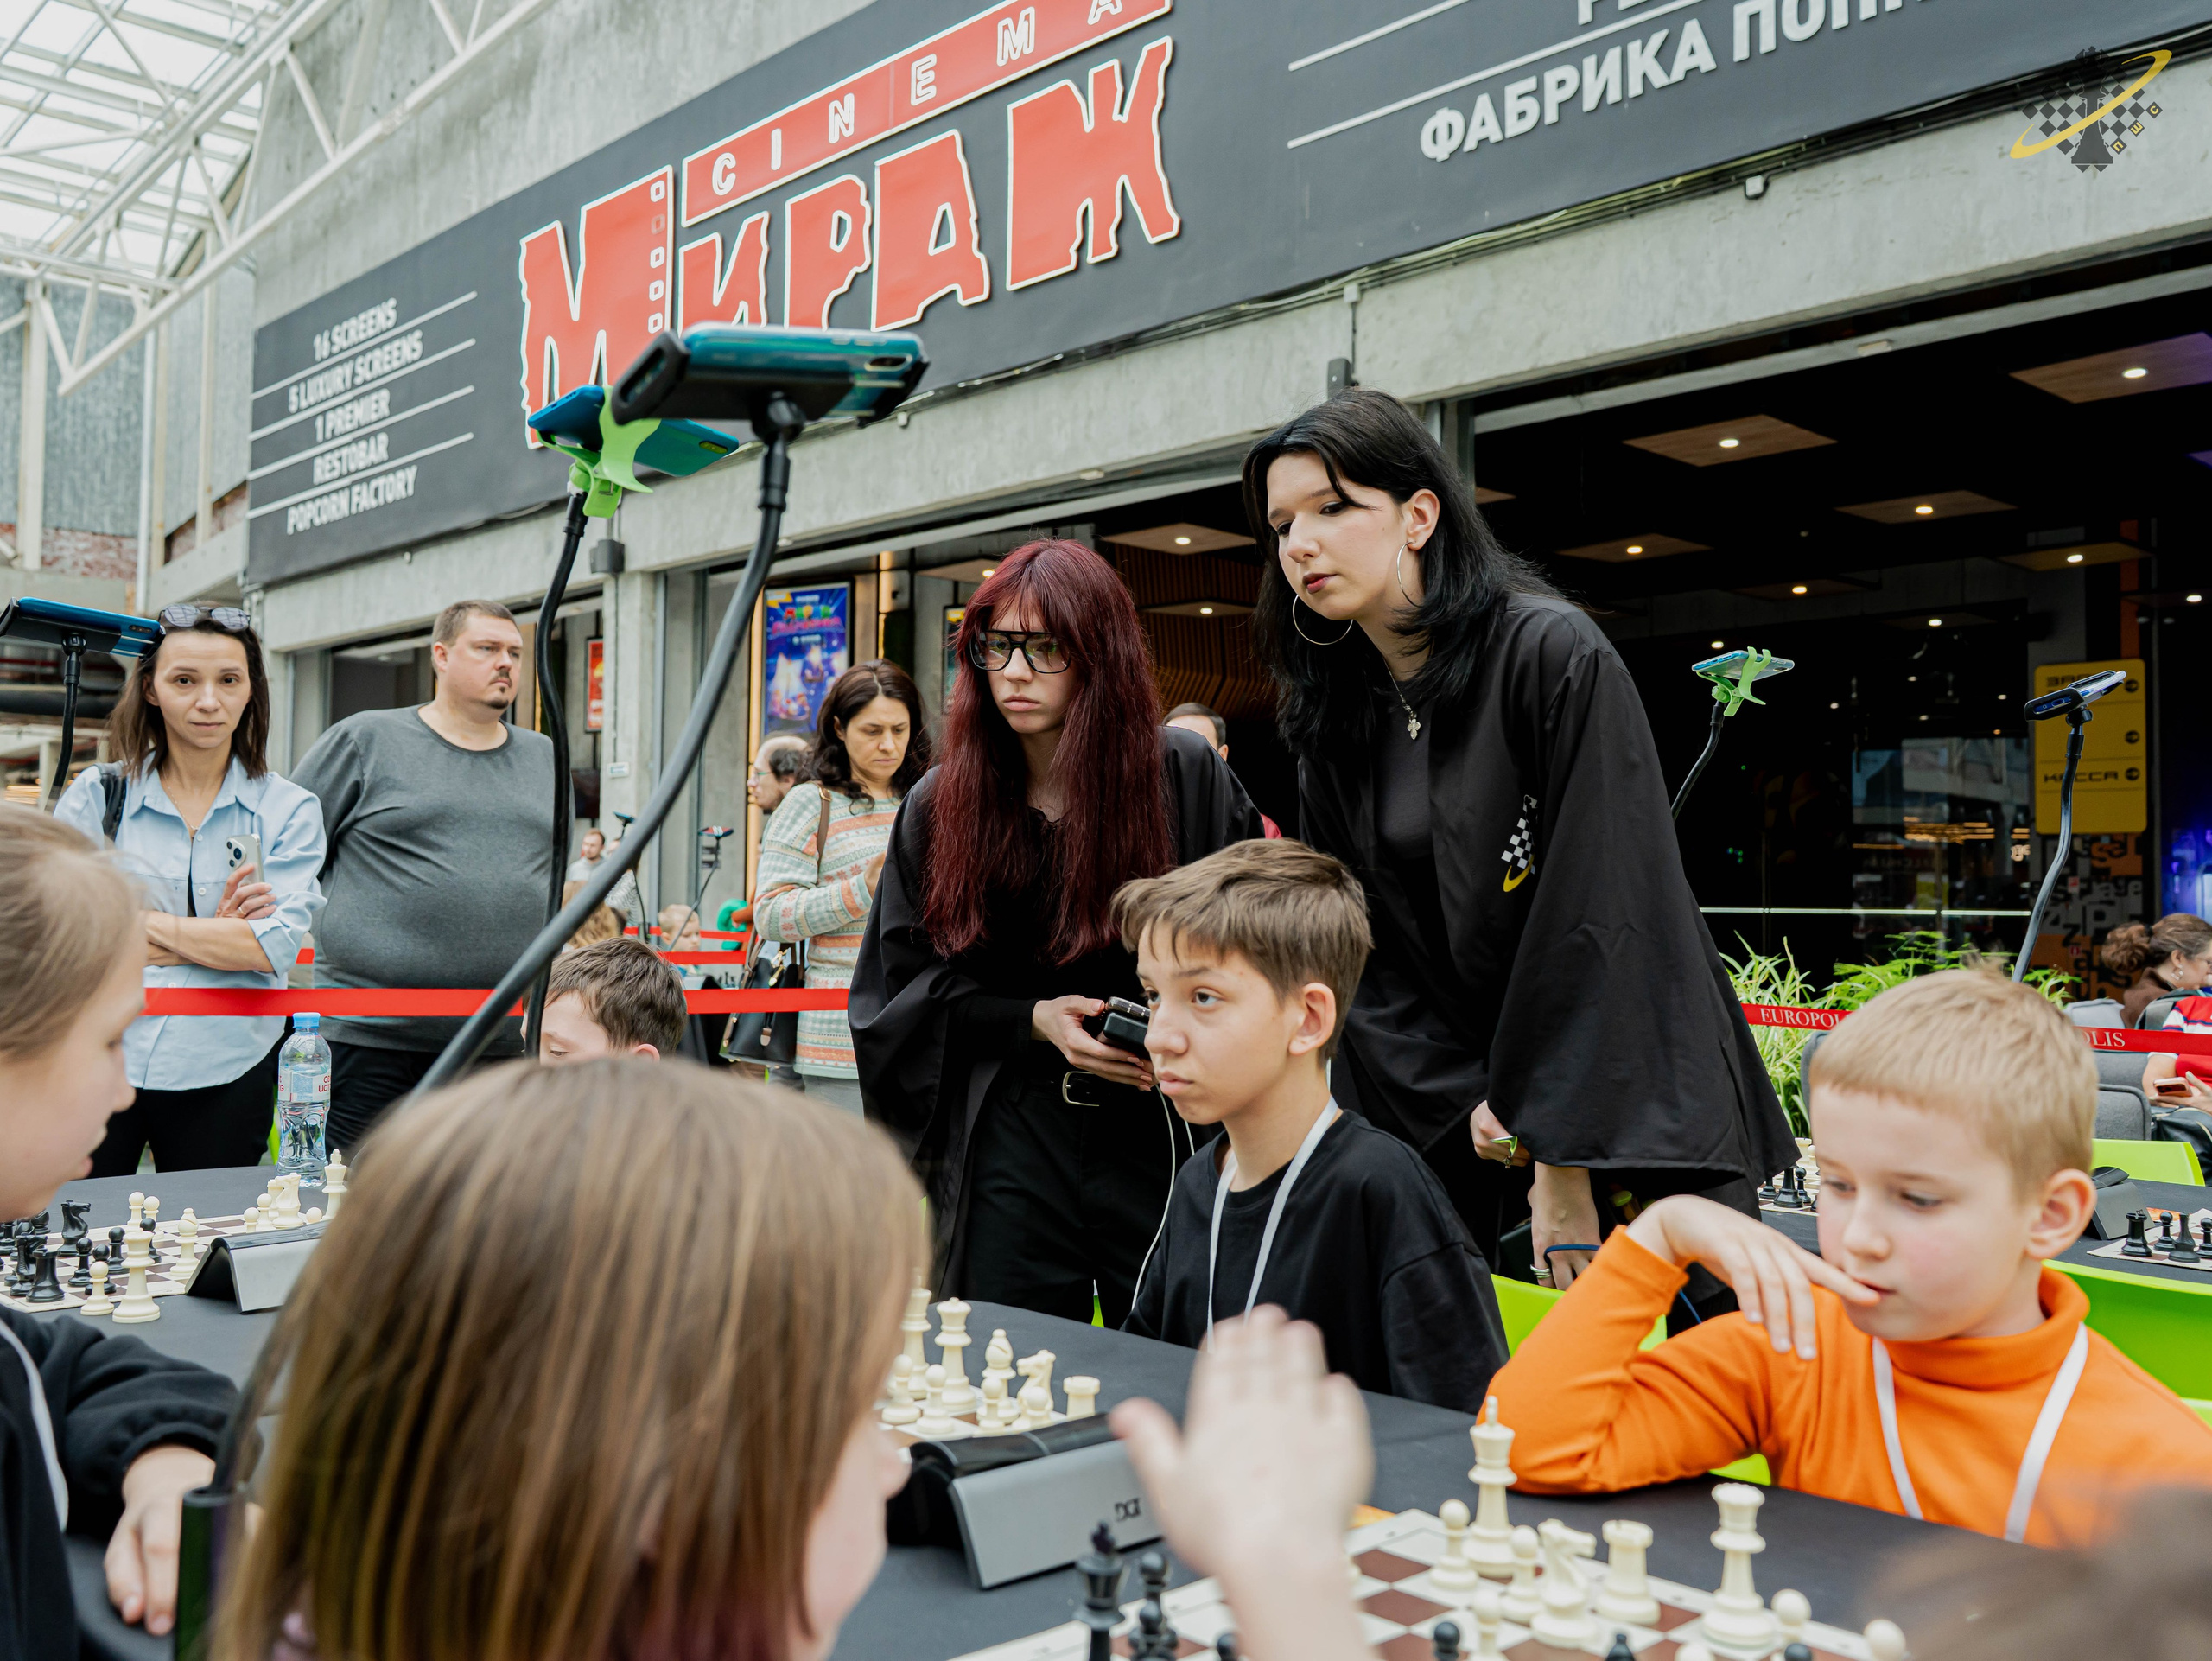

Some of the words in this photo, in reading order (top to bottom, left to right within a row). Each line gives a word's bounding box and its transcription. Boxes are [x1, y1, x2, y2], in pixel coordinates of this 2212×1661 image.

[1420, 17, 1718, 162] ФАБРИКА
[331, 298, 397, 353] SCREENS
[298, 359, 354, 410] LUXURY
[353, 328, 423, 385] SCREENS
[324, 388, 391, 441] PREMIER
[312, 431, 390, 486] RESTOBAR
[286, 487, 351, 536] POPCORN
[350, 464, 418, 516] FACTORY
[2044, 771, 2119, 783] КССА
[1759, 1008, 1840, 1028] EUROPOL
